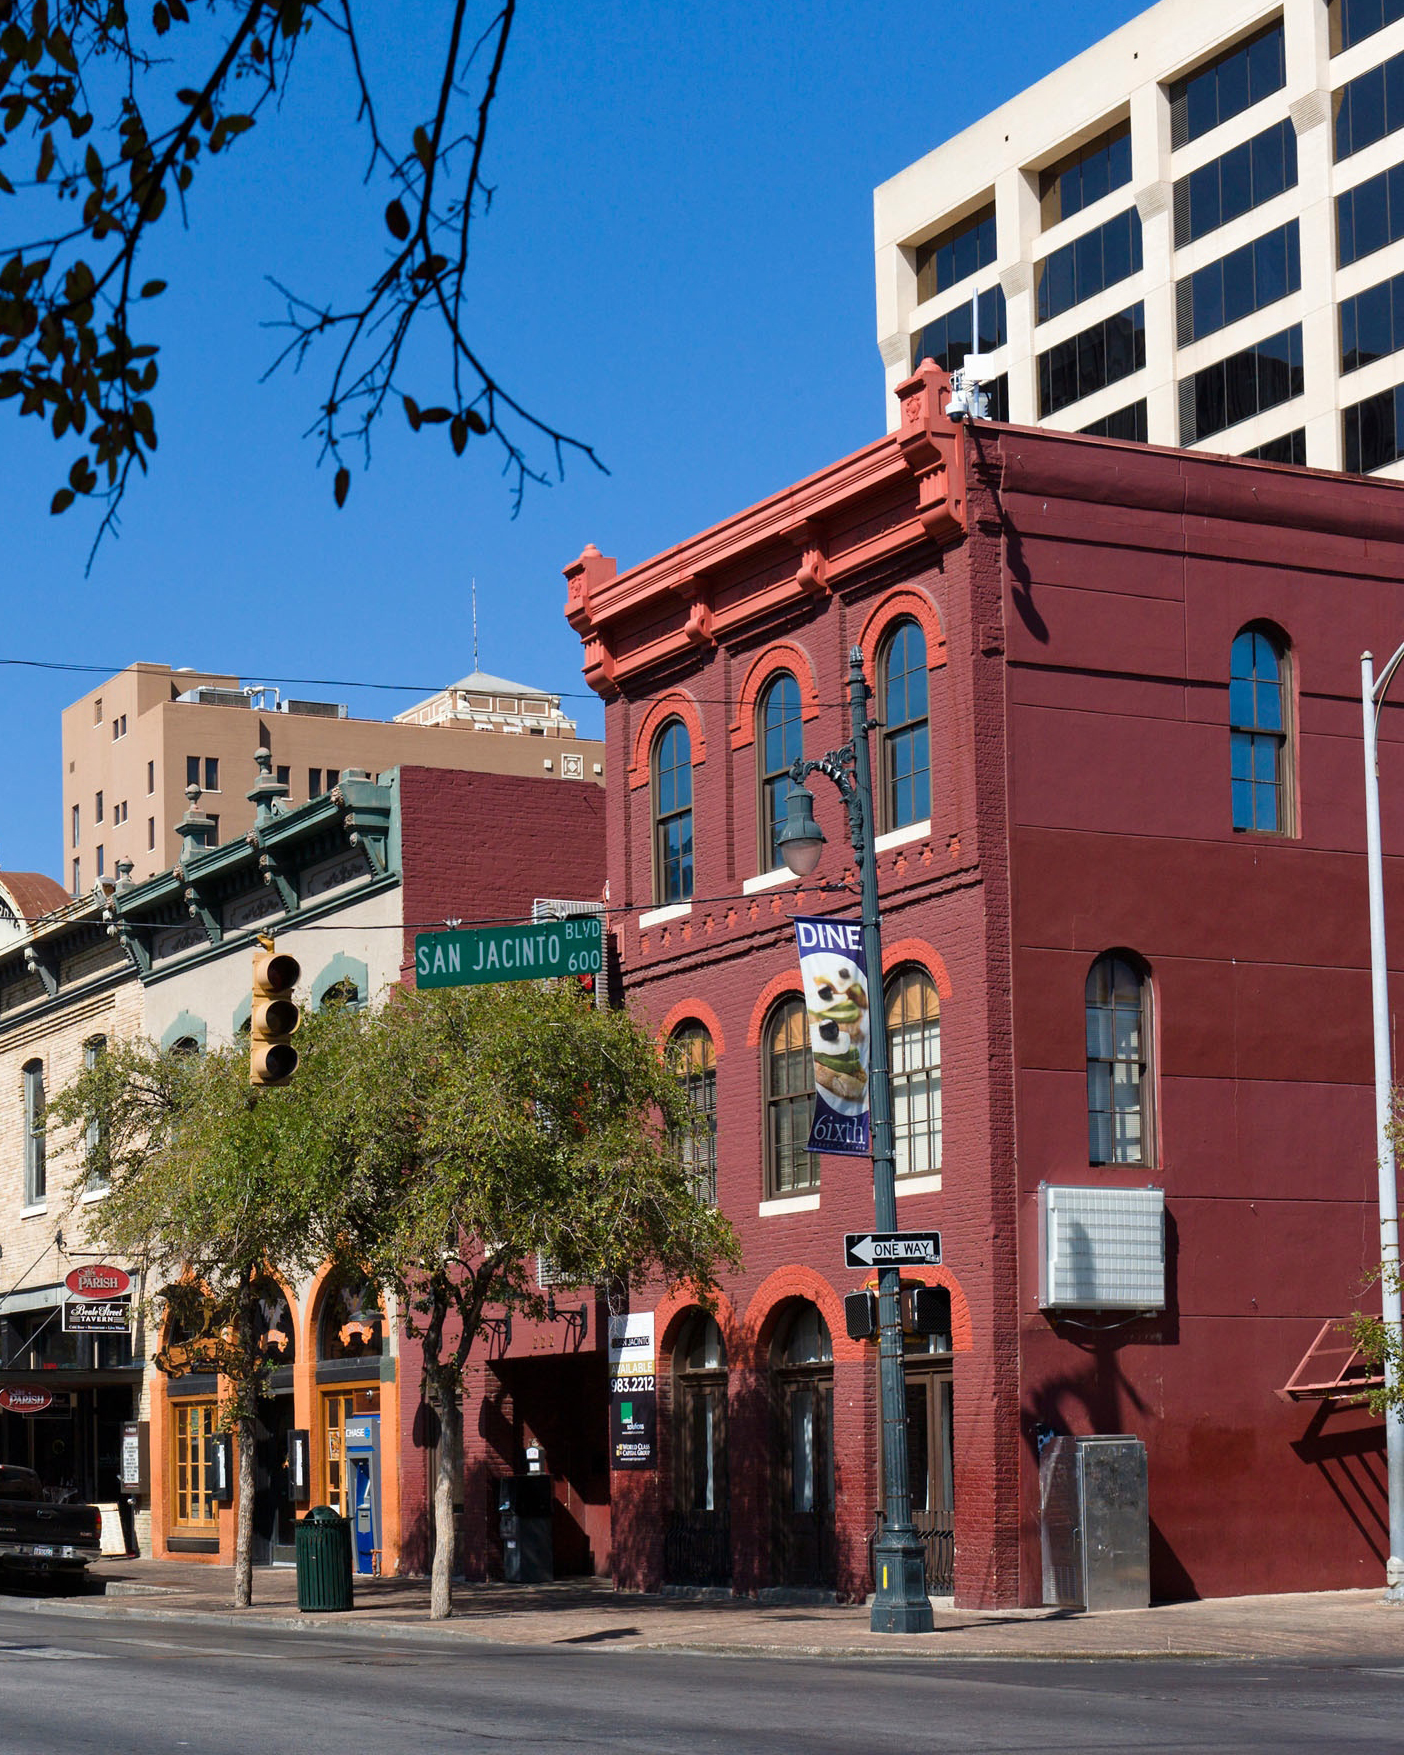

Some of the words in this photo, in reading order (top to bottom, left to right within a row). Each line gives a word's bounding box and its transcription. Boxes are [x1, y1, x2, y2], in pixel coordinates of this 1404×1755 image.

[797, 922, 863, 951] DINE
[418, 943, 461, 976] SAN
[473, 934, 560, 971] JACINTO
[566, 920, 600, 940] BLVD
[568, 950, 600, 972] 600
[814, 1114, 866, 1145] 6ixth
[874, 1243, 899, 1257] ONE
[904, 1242, 930, 1255] WAY
[71, 1303, 98, 1316] Beale
[98, 1303, 122, 1316] Street
[628, 1336, 649, 1347] JACINTO
[611, 1362, 653, 1375] AVAILABLE
[611, 1376, 655, 1393] 983.2212
[346, 1428, 365, 1438] CHASE
